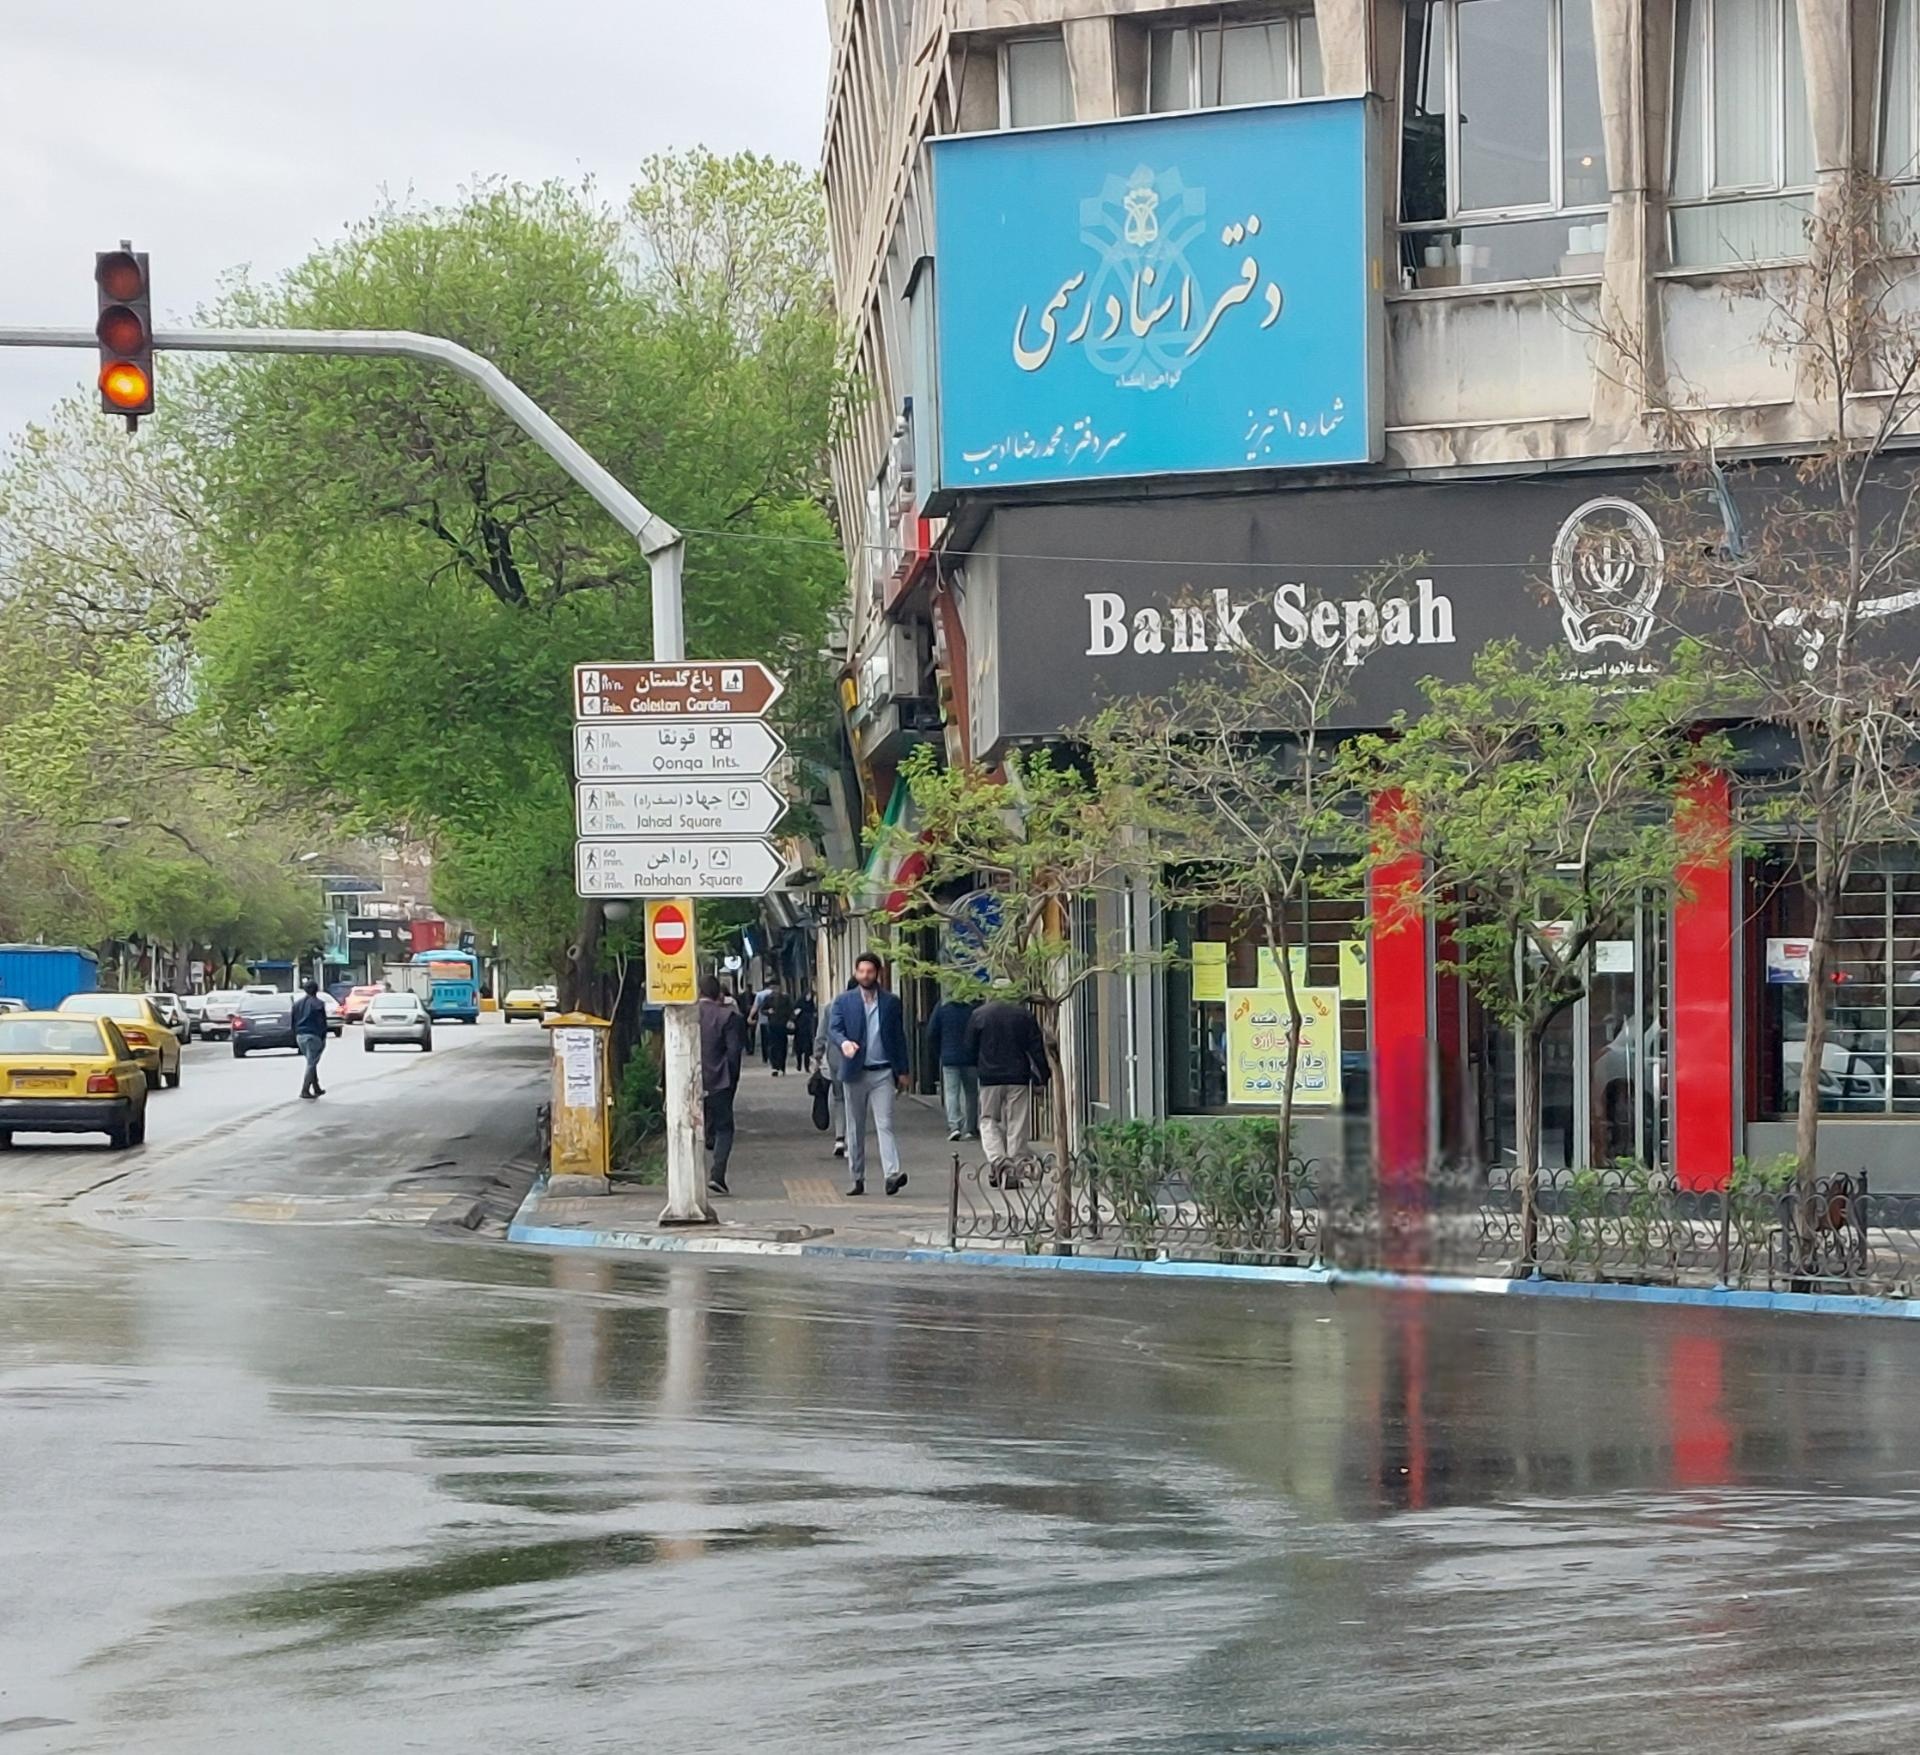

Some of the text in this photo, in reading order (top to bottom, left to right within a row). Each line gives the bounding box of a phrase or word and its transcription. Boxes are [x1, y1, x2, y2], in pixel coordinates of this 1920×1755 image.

[1012, 213, 1285, 372] دفتر اسناد رسمی
[1297, 396, 1345, 437] شماره
[1244, 407, 1279, 461] تبریز
[1084, 578, 1456, 667] Bank Sepah
[635, 669, 713, 693] باغ گلستان
[630, 696, 731, 712] Golestan Garden
[653, 756, 703, 771] Qonqa
[685, 789, 722, 810] جهاد
[637, 814, 722, 829] Jahad Square
[680, 849, 699, 870] راه
[634, 873, 743, 888] Rahahan Square
